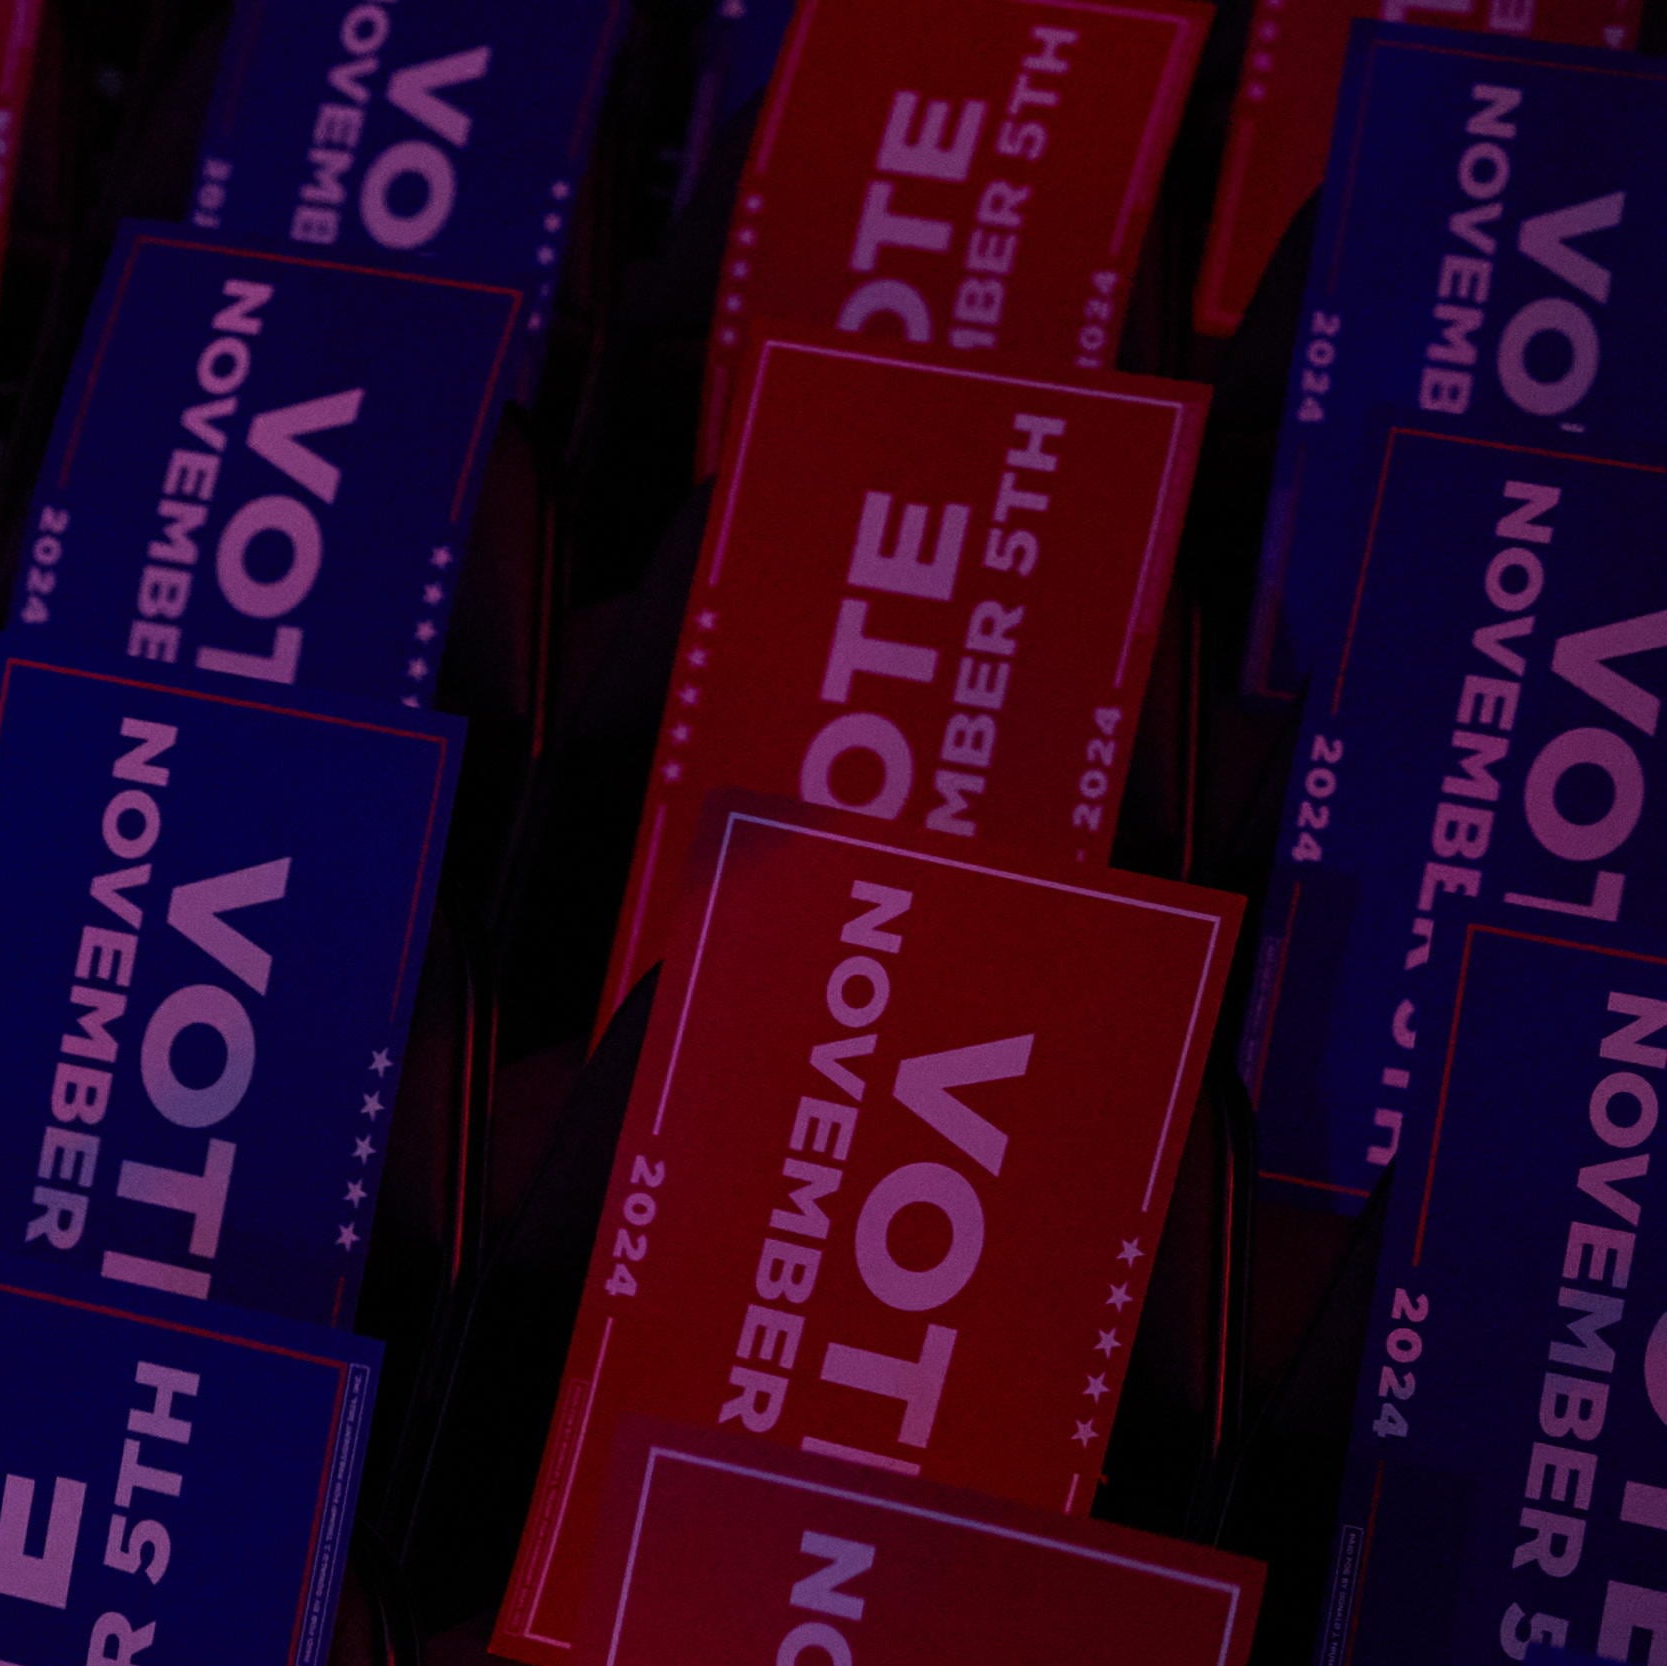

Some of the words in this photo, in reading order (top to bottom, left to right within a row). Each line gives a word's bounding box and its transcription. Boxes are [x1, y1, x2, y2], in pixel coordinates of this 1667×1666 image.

[291, 4, 389, 244] OVEMB
[361, 47, 489, 249] VO
[998, 27, 1076, 159] 5TH
[839, 92, 984, 342] OTE
[1419, 84, 1522, 414] NOVEMB
[1497, 191, 1625, 434] VO
[127, 280, 273, 663] NOVEMBE
[1298, 311, 1340, 422] 2024
[21, 507, 69, 623] 2024
[196, 389, 363, 685] VOT
[801, 491, 969, 820] OTE
[926, 601, 1024, 837] MBER
[984, 414, 1065, 575] 5TH
[1073, 708, 1121, 830] 2024
[1291, 735, 1343, 862] 2024
[1504, 609, 1667, 922] VOT
[25, 717, 178, 1250] NOVEMBER
[605, 1154, 665, 1297] 2024
[718, 879, 913, 1433] NOVEMBER
[801, 1033, 1035, 1475] VOT
[1372, 1287, 1429, 1438] 2024
[1511, 991, 1667, 1578] NOVEMBER
[103, 1360, 201, 1585] 5TH
